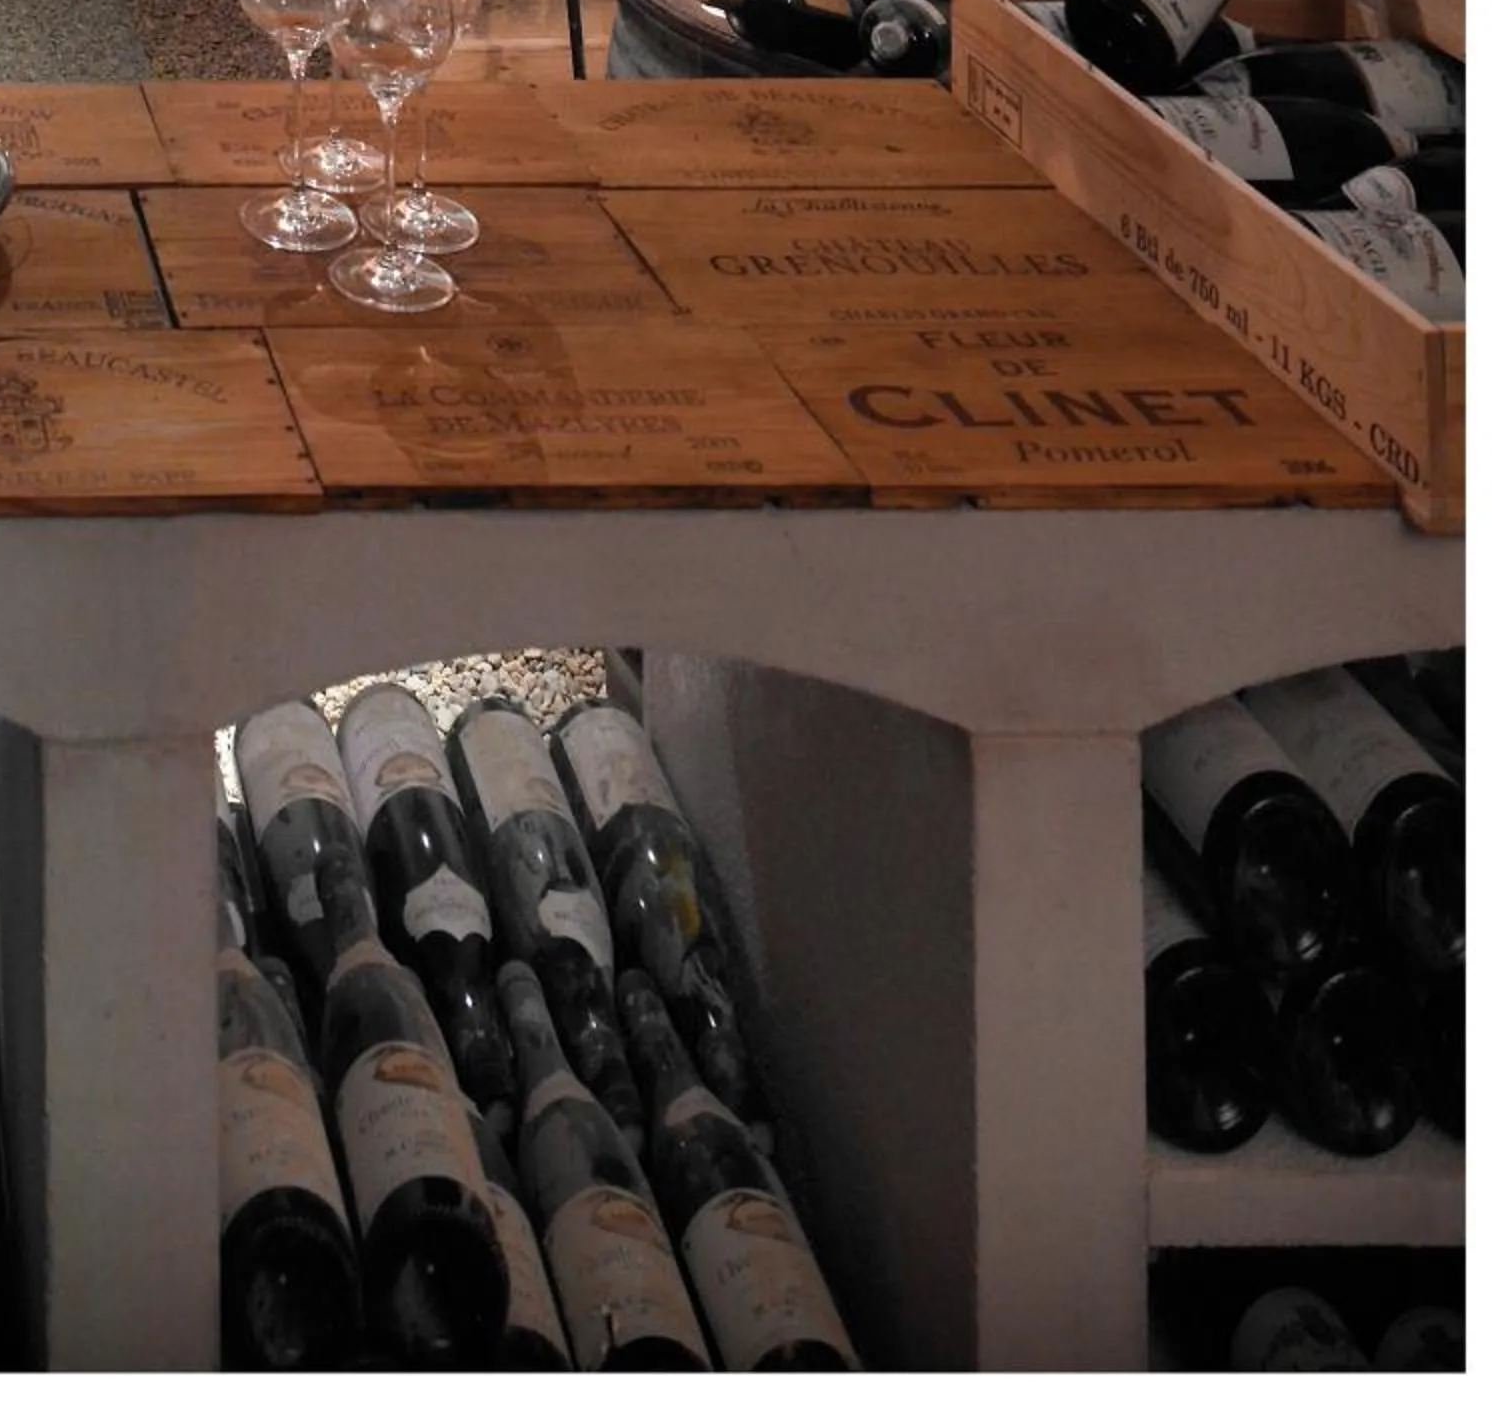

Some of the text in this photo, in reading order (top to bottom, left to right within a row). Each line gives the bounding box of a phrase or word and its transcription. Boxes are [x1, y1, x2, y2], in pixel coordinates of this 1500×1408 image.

[709, 253, 1090, 278] GRENOUILLES
[916, 329, 1073, 350] FLEUR
[1164, 247, 1187, 282] de
[1188, 267, 1220, 311] 750
[1224, 300, 1250, 338] ml
[1271, 334, 1292, 375] 11
[1298, 357, 1348, 422] KGS
[16, 347, 229, 405] BEAUCASTEL
[991, 358, 1060, 377] DE
[846, 383, 1259, 430] CLINET
[1012, 437, 1198, 465] Pomerol
